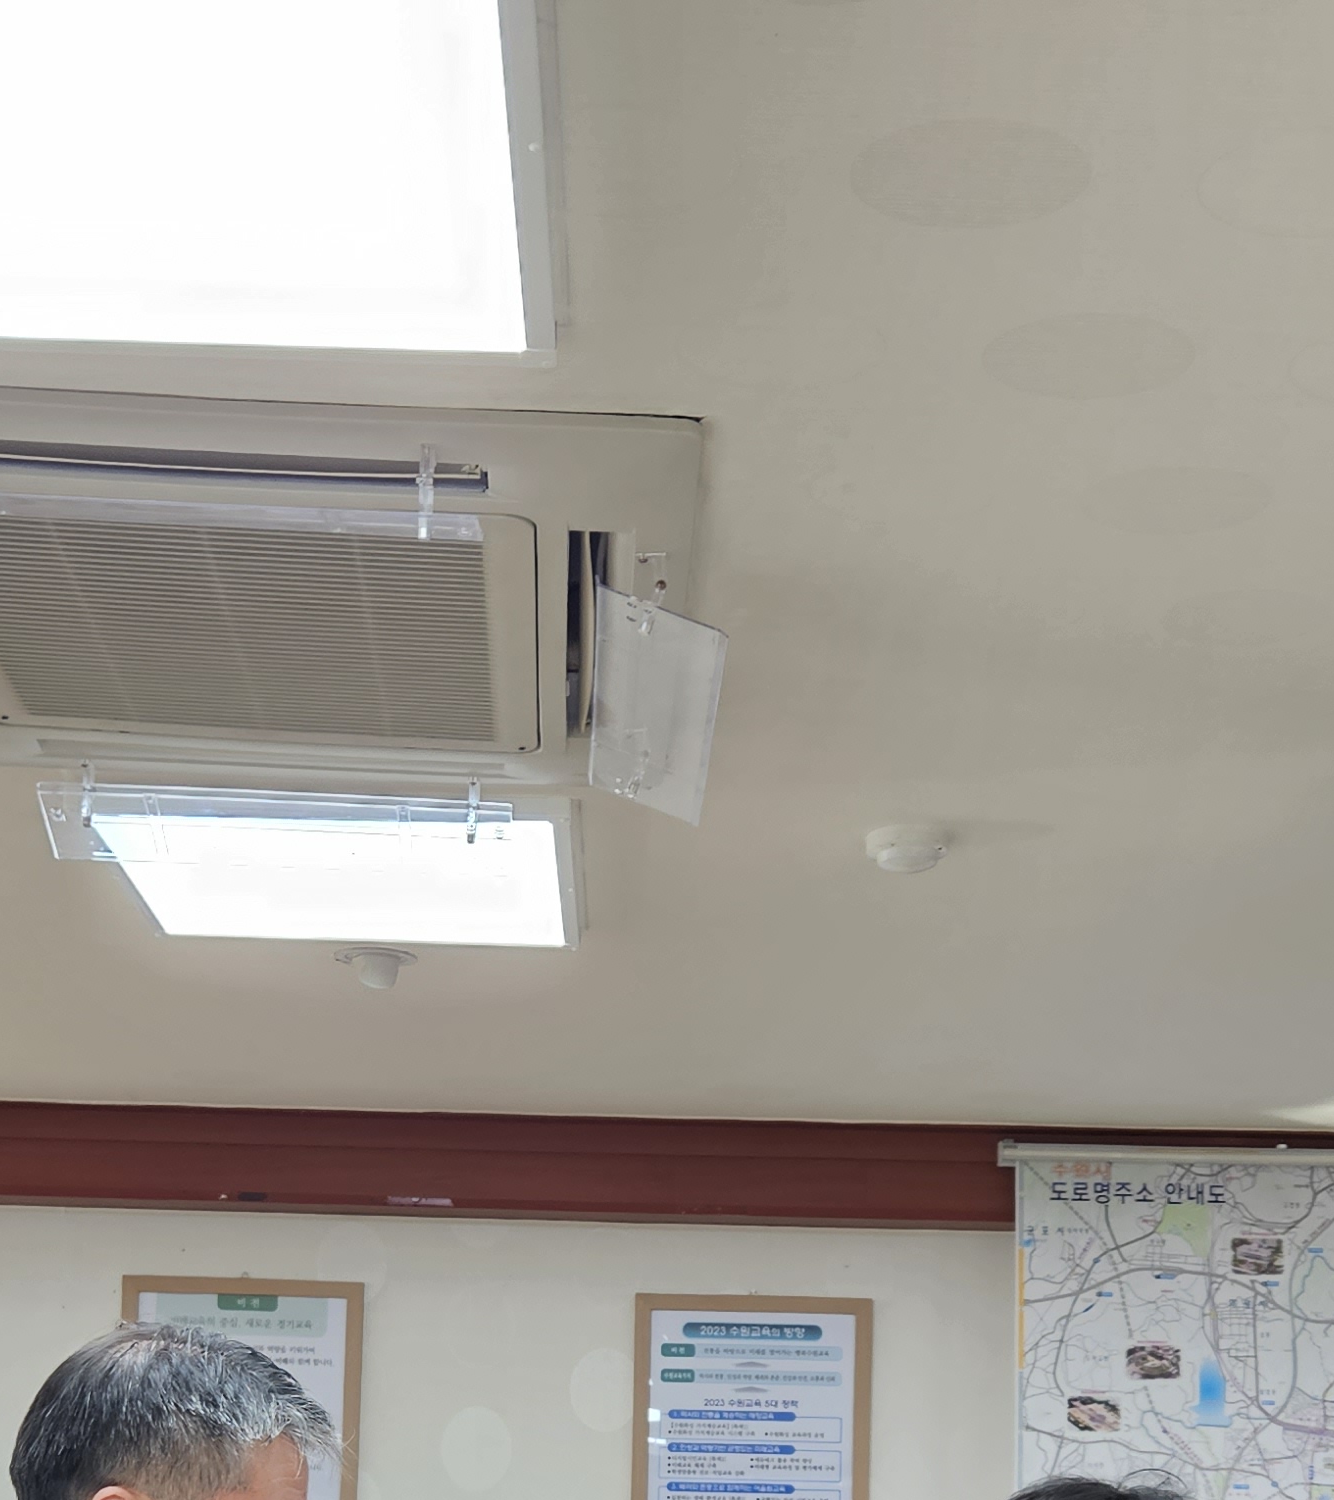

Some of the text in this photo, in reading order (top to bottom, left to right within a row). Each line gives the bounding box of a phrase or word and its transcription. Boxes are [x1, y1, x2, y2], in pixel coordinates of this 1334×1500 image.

[1049, 1181, 1227, 1206] 도로명주소 안내도
[245, 1317, 272, 1329] 새로운
[277, 1319, 313, 1330] 경기교육
[700, 1325, 806, 1339] 2023 수원교육의 방향
[703, 1398, 799, 1409] 2023 수원교육 5대 정책
